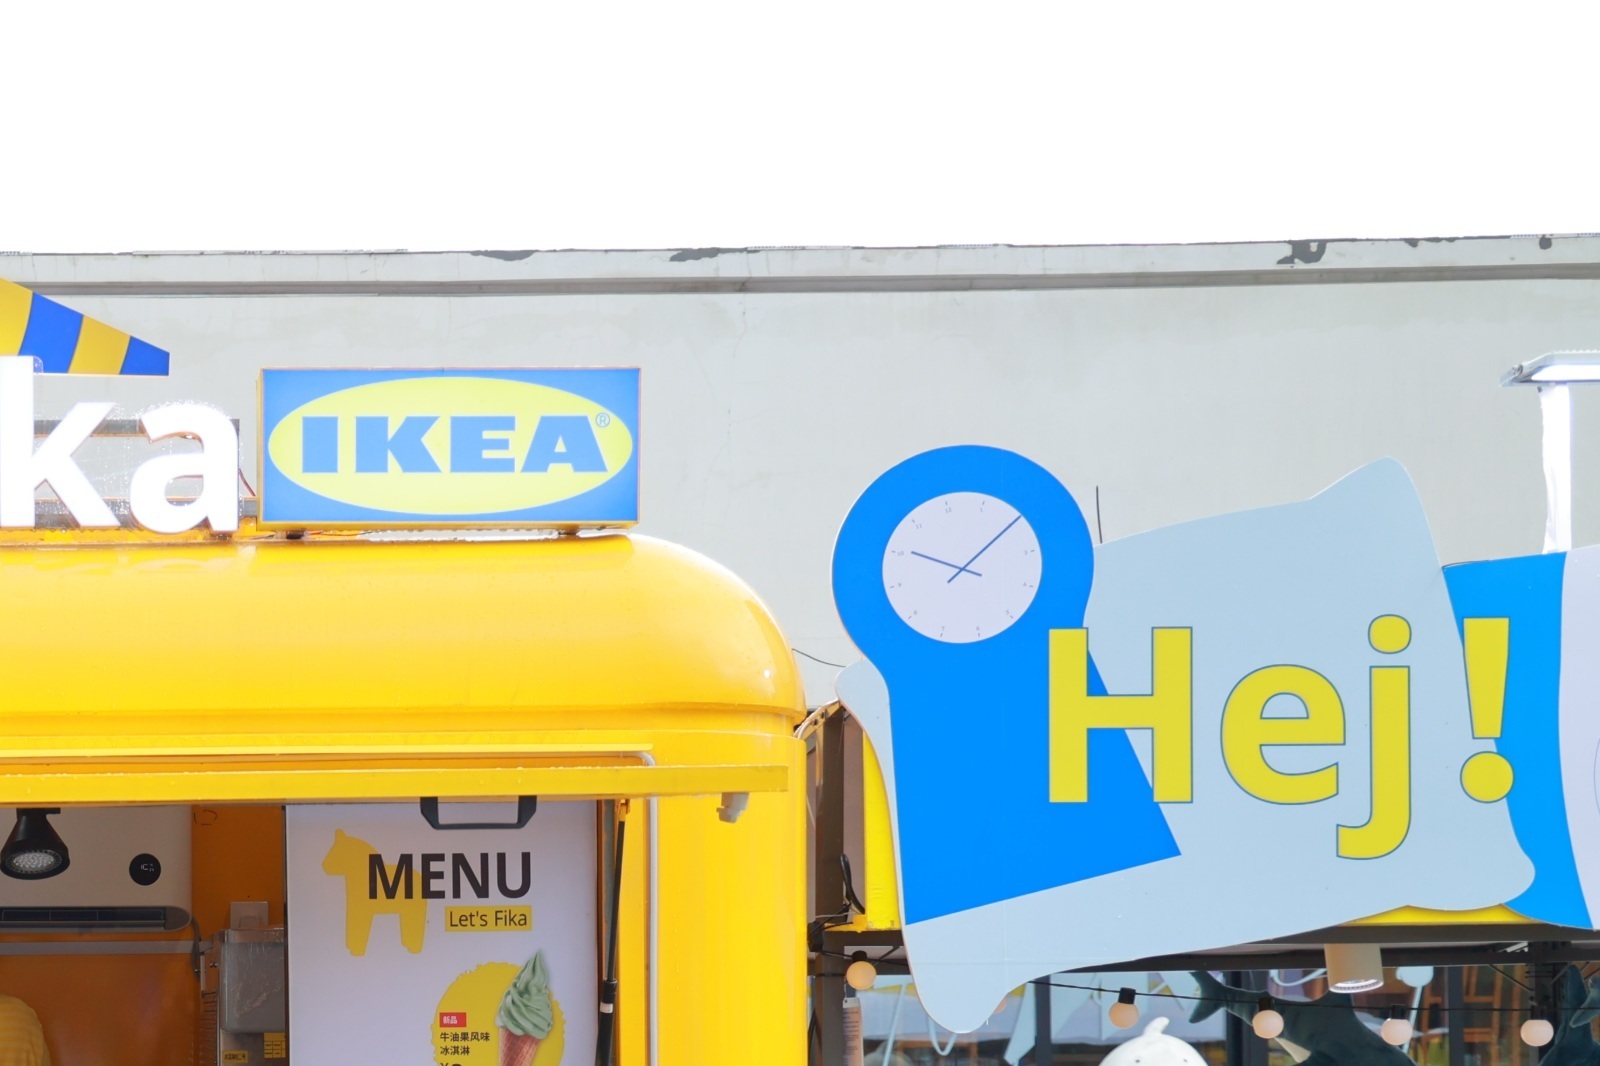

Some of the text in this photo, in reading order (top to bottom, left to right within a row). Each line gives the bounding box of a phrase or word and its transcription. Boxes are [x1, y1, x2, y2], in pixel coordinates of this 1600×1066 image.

[301, 415, 610, 473] IKEA
[1048, 614, 1514, 860] Hej!
[368, 852, 532, 899] MENU
[449, 909, 527, 927] Let's Fika
[440, 1032, 490, 1042] 牛油果风味
[440, 1045, 470, 1056] 冰淇淋
